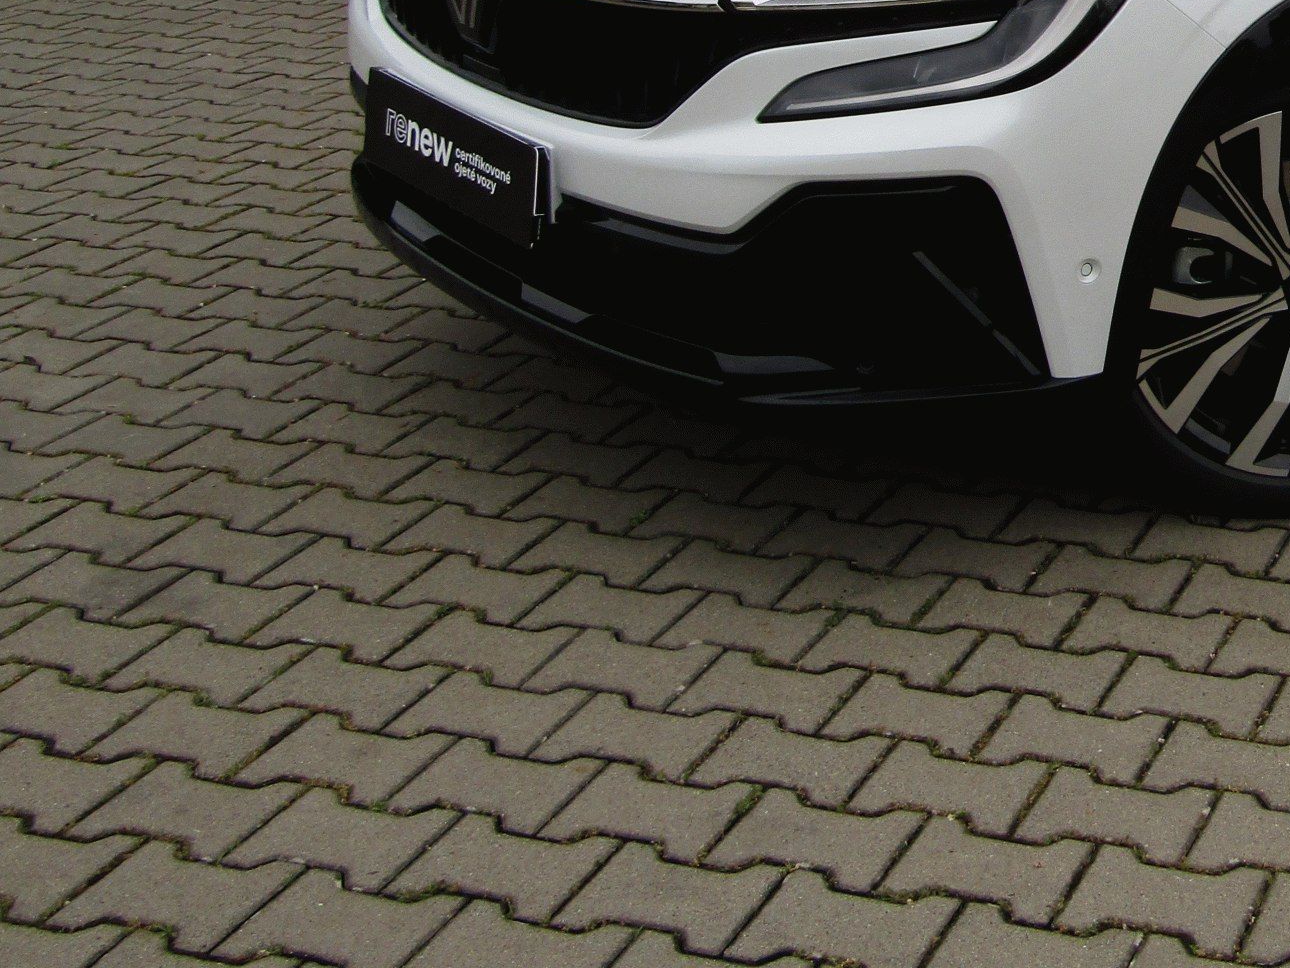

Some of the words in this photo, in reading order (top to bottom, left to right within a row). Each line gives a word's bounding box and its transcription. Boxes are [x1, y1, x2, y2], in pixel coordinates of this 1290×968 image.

[385, 107, 454, 167] renew
[454, 162, 476, 181] ojeté
[476, 173, 497, 195] vozy
[455, 147, 511, 185] certifikované
